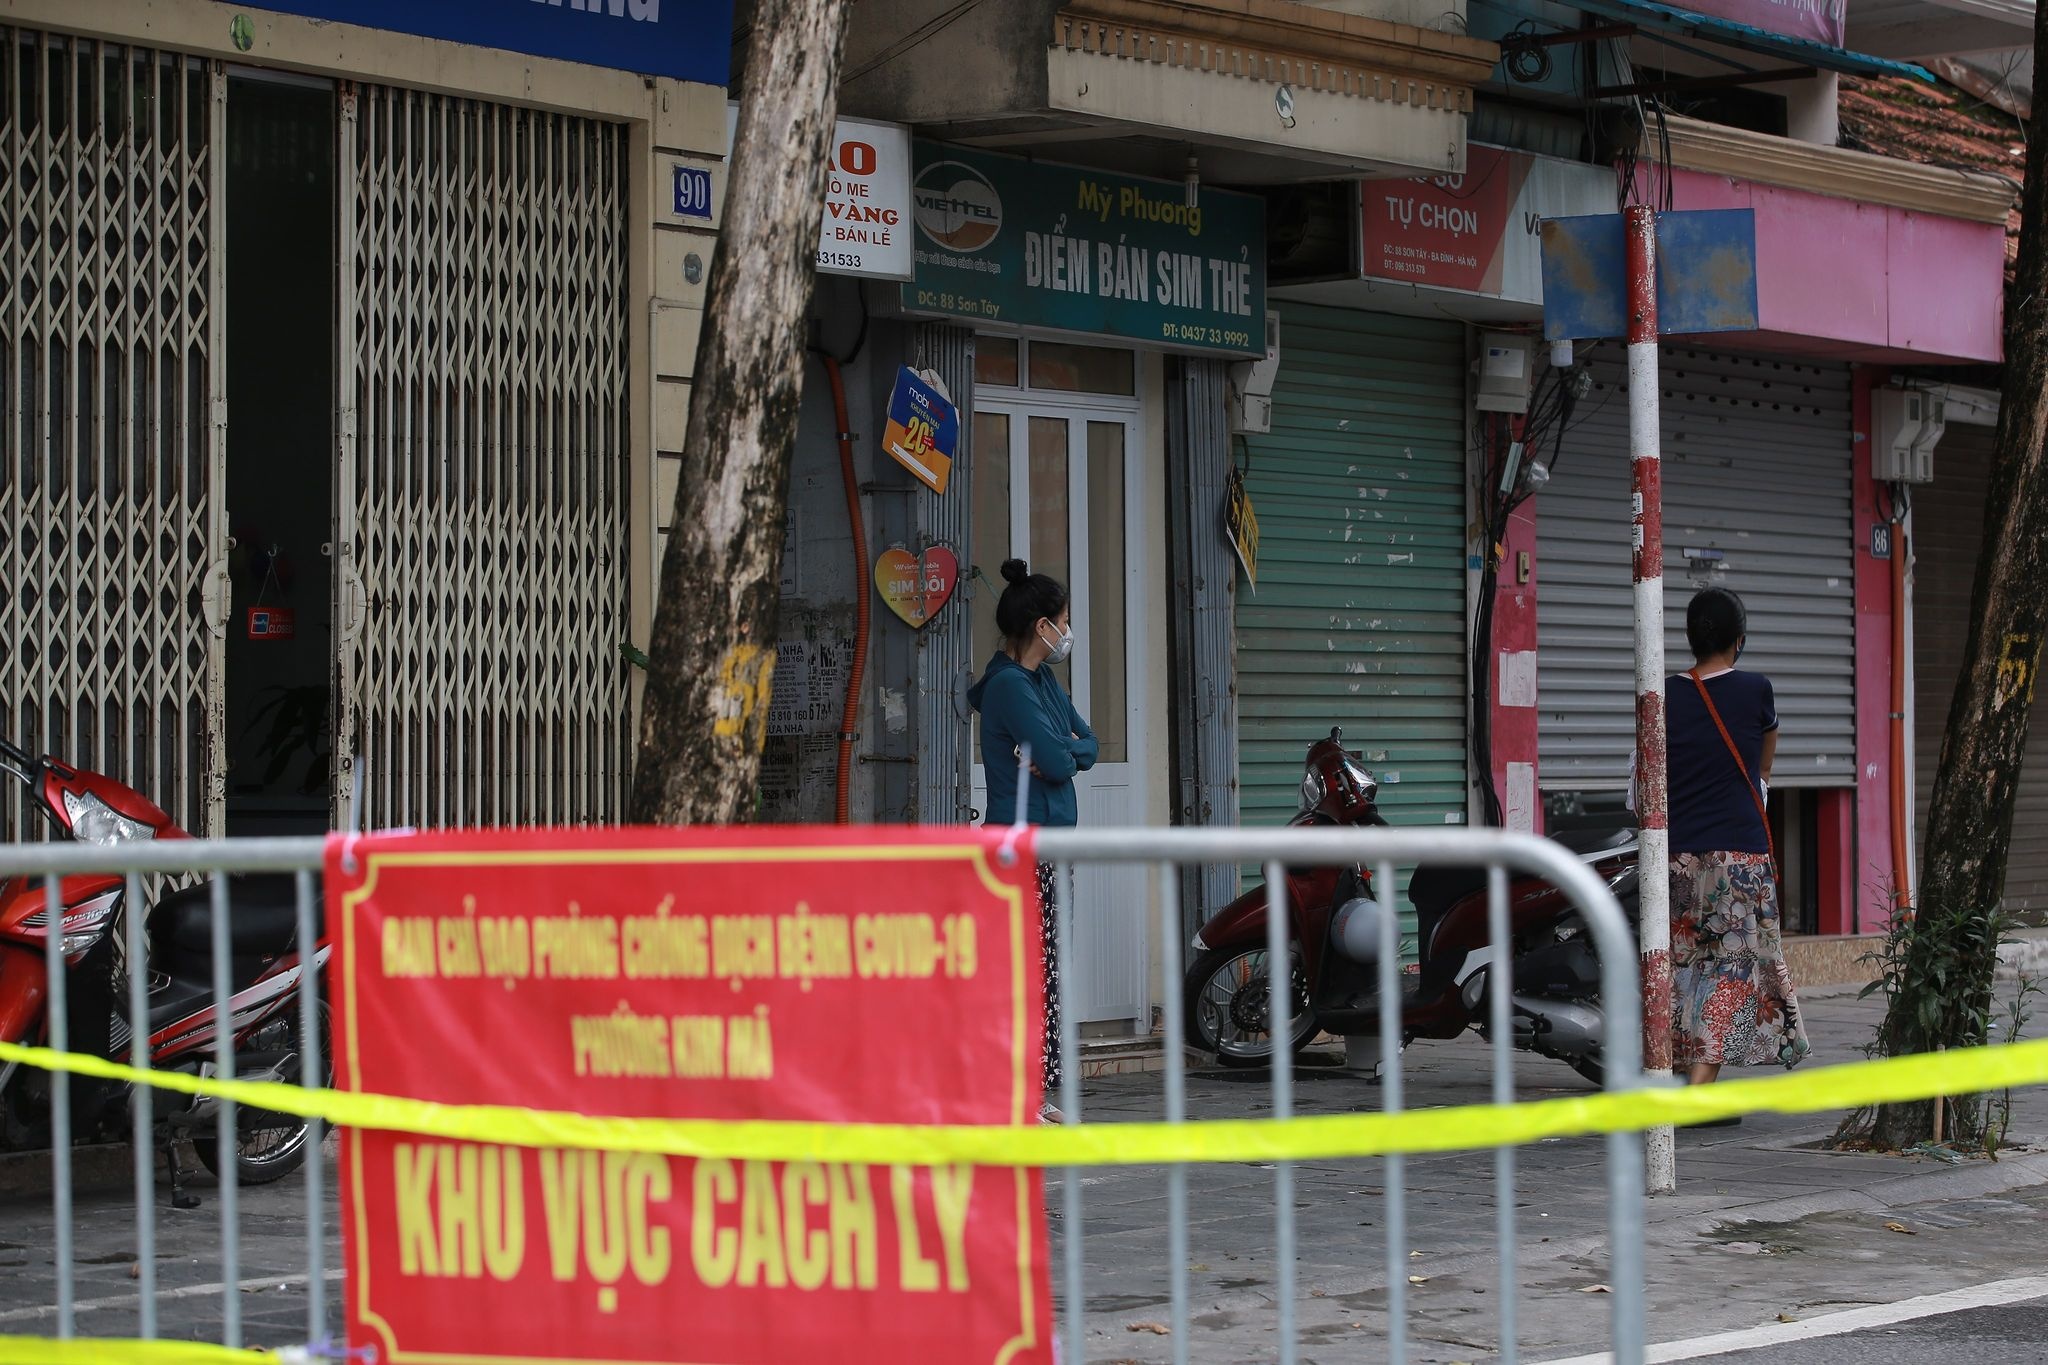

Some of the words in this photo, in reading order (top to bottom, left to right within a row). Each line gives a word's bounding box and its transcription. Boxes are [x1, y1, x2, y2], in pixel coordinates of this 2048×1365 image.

[680, 172, 706, 210] 90
[847, 182, 869, 198] ME
[827, 199, 899, 226] VÀNG
[1078, 180, 1113, 223] Mỹ
[1119, 186, 1201, 237] Phương
[1385, 196, 1414, 231] TỰ
[1419, 202, 1478, 238] CHỌN
[836, 225, 867, 243] BÁN
[873, 227, 891, 246] LẺ
[1025, 213, 1090, 295] ĐIỂM
[1098, 233, 1149, 303] BÁN
[1156, 250, 1202, 310] SIM
[1208, 244, 1251, 317] THẺ
[918, 290, 937, 307] ĐC:
[940, 293, 954, 309] 88
[957, 296, 977, 313] Sơn
[980, 299, 1000, 319] Tây
[1162, 322, 1179, 338] ĐT:
[1181, 325, 1206, 341] 0437
[1209, 328, 1222, 344] 33
[1224, 330, 1249, 347] 9992
[1874, 528, 1887, 553] 86
[888, 579, 914, 595] SIM
[778, 710, 791, 721] 810
[793, 710, 808, 721] 160
[383, 915, 437, 979] BAN
[438, 894, 482, 980] CHỈ
[532, 900, 620, 980] PHÒNG
[622, 893, 709, 980] CHỐNG
[711, 914, 775, 993] DỊCH
[777, 901, 853, 993] BỆNH
[854, 912, 977, 980] COVID-19
[571, 999, 672, 1078] PHƯỜNG
[672, 1014, 725, 1080] KIM
[727, 1003, 774, 1080] MÃ
[394, 1143, 525, 1281] KHU
[538, 1147, 672, 1314] VỰC
[891, 1162, 976, 1293] LY
